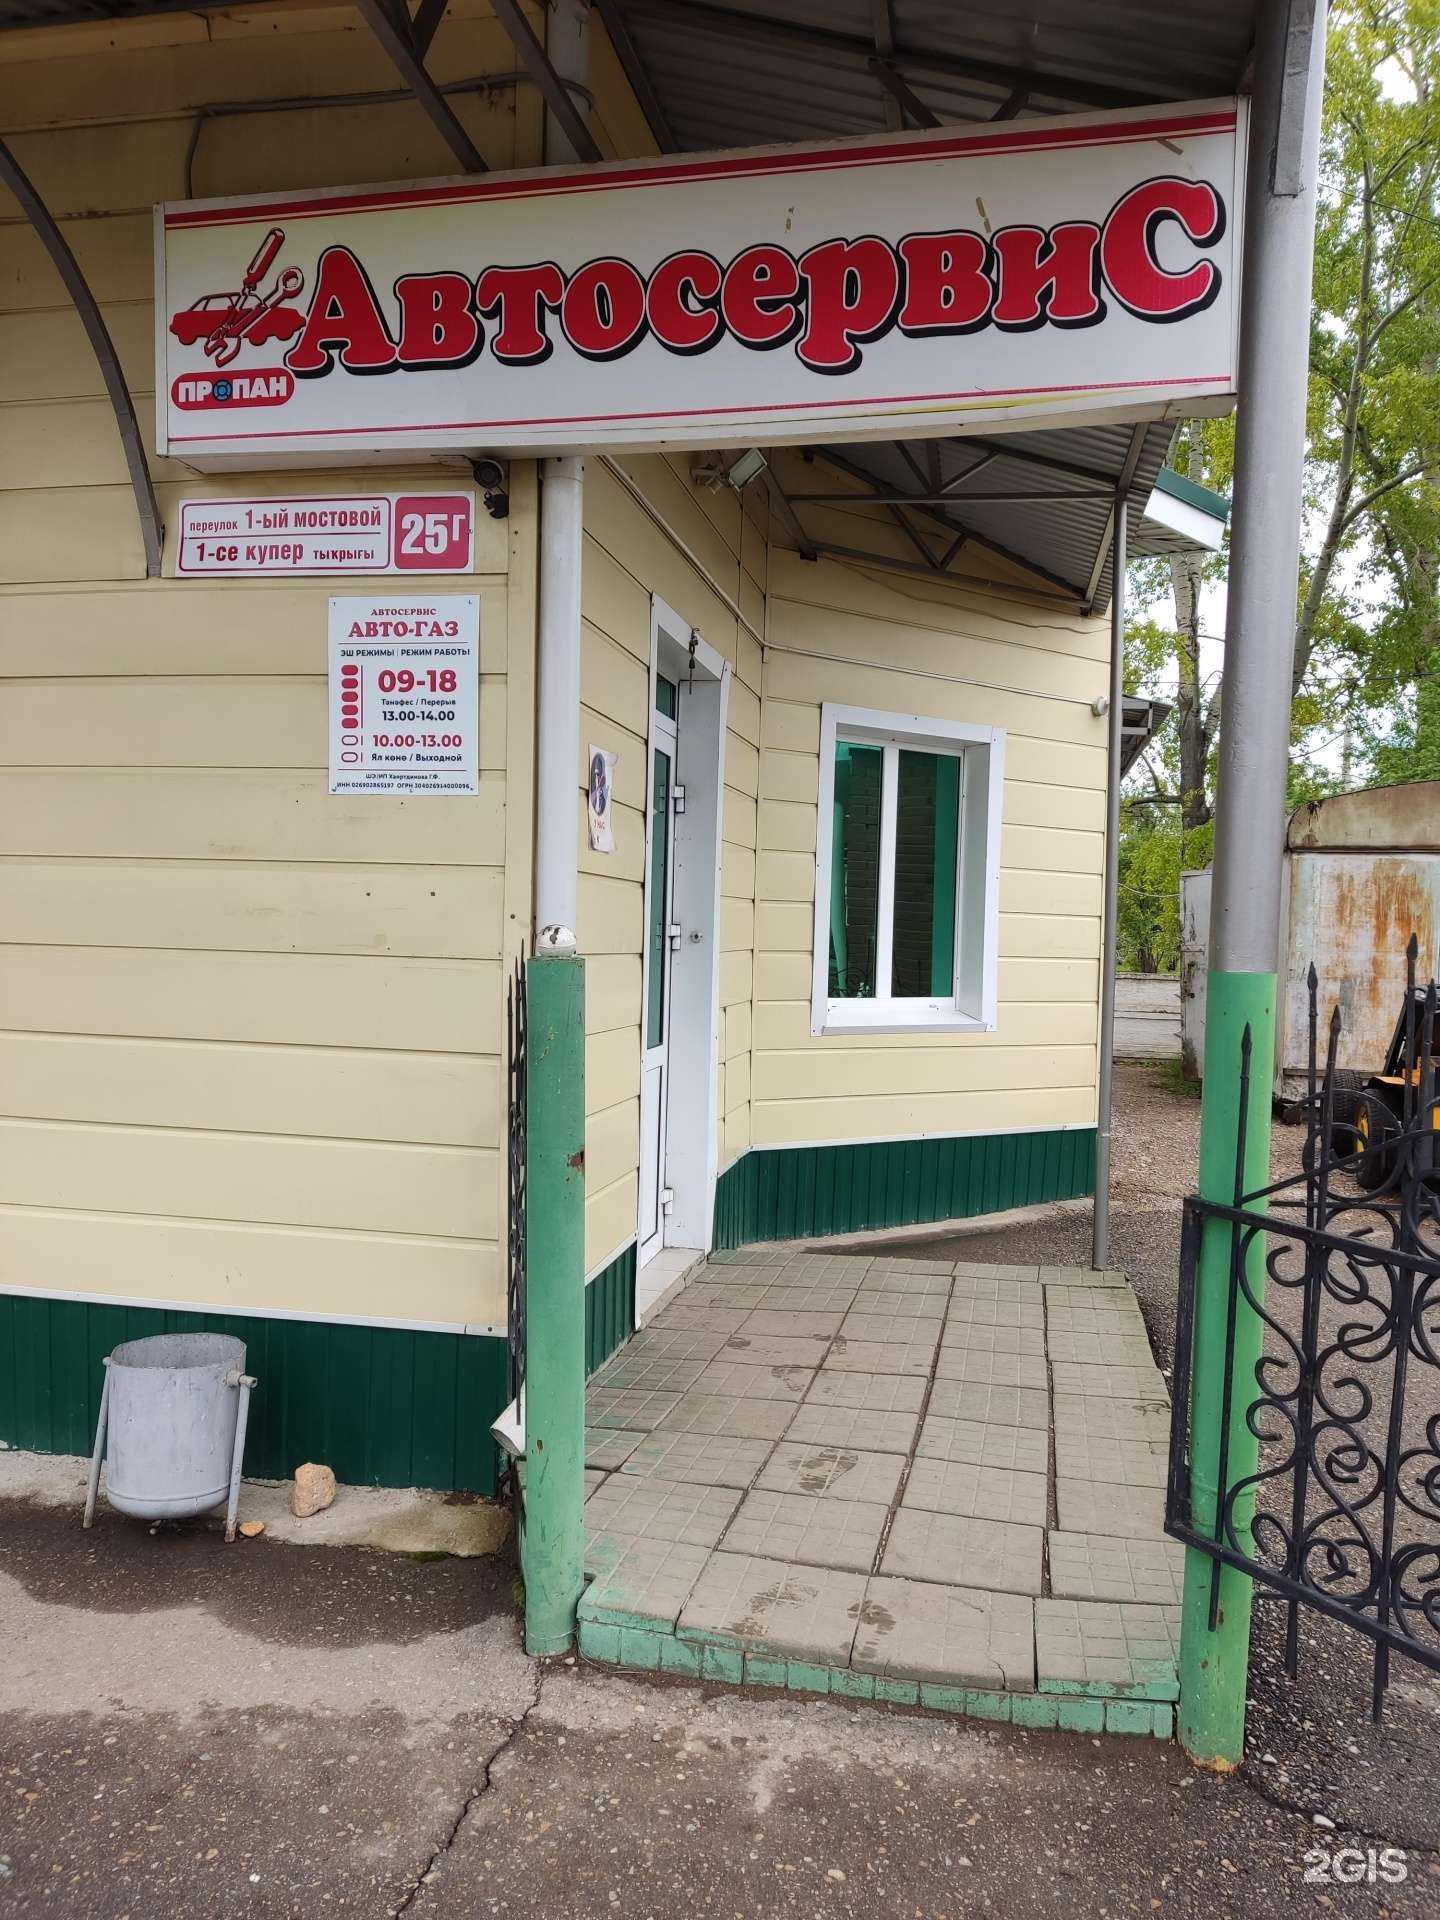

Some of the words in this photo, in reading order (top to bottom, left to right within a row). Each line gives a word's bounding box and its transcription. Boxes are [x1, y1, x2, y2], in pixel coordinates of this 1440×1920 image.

[177, 375, 288, 403] ПРОПАН
[189, 520, 238, 533] переулок
[245, 506, 288, 530] 1-ый
[294, 505, 381, 528] мостовой
[196, 543, 239, 562] 1-се
[370, 608, 437, 616] АВТОСЕРВИС
[348, 620, 459, 637] АВТО-ГАЗ
[341, 649, 354, 657] ЭШ
[356, 649, 395, 657] РЕЖИМЫ
[401, 648, 432, 656] РЕЖИМ
[434, 648, 470, 656] РАБОТЫ
[378, 669, 457, 693] 09-18
[421, 698, 456, 706] Перерыв
[382, 710, 455, 721] 13.00-14.00
[372, 734, 462, 747] 10.00-13.00
[371, 753, 382, 761] Ял
[415, 753, 462, 762] Выходной
